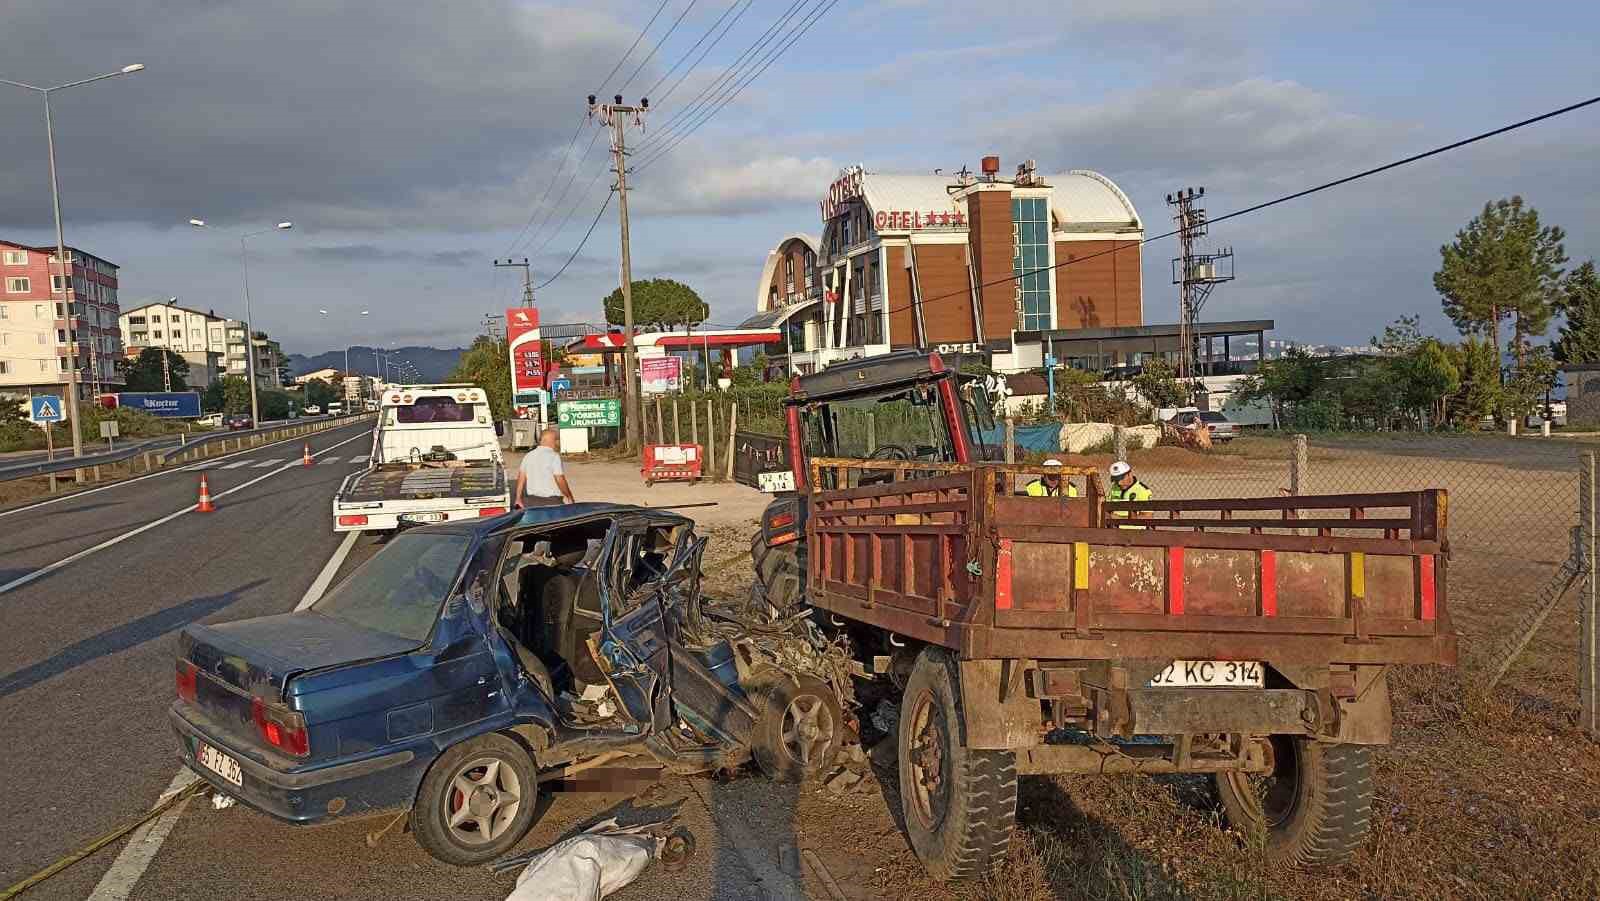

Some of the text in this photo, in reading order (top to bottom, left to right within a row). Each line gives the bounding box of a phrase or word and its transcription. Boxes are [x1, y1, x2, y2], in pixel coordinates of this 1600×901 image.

[875, 210, 923, 229] OTEL
[938, 342, 981, 353] OTEL
[1185, 662, 1214, 683] KC
[1225, 662, 1259, 683] 314
